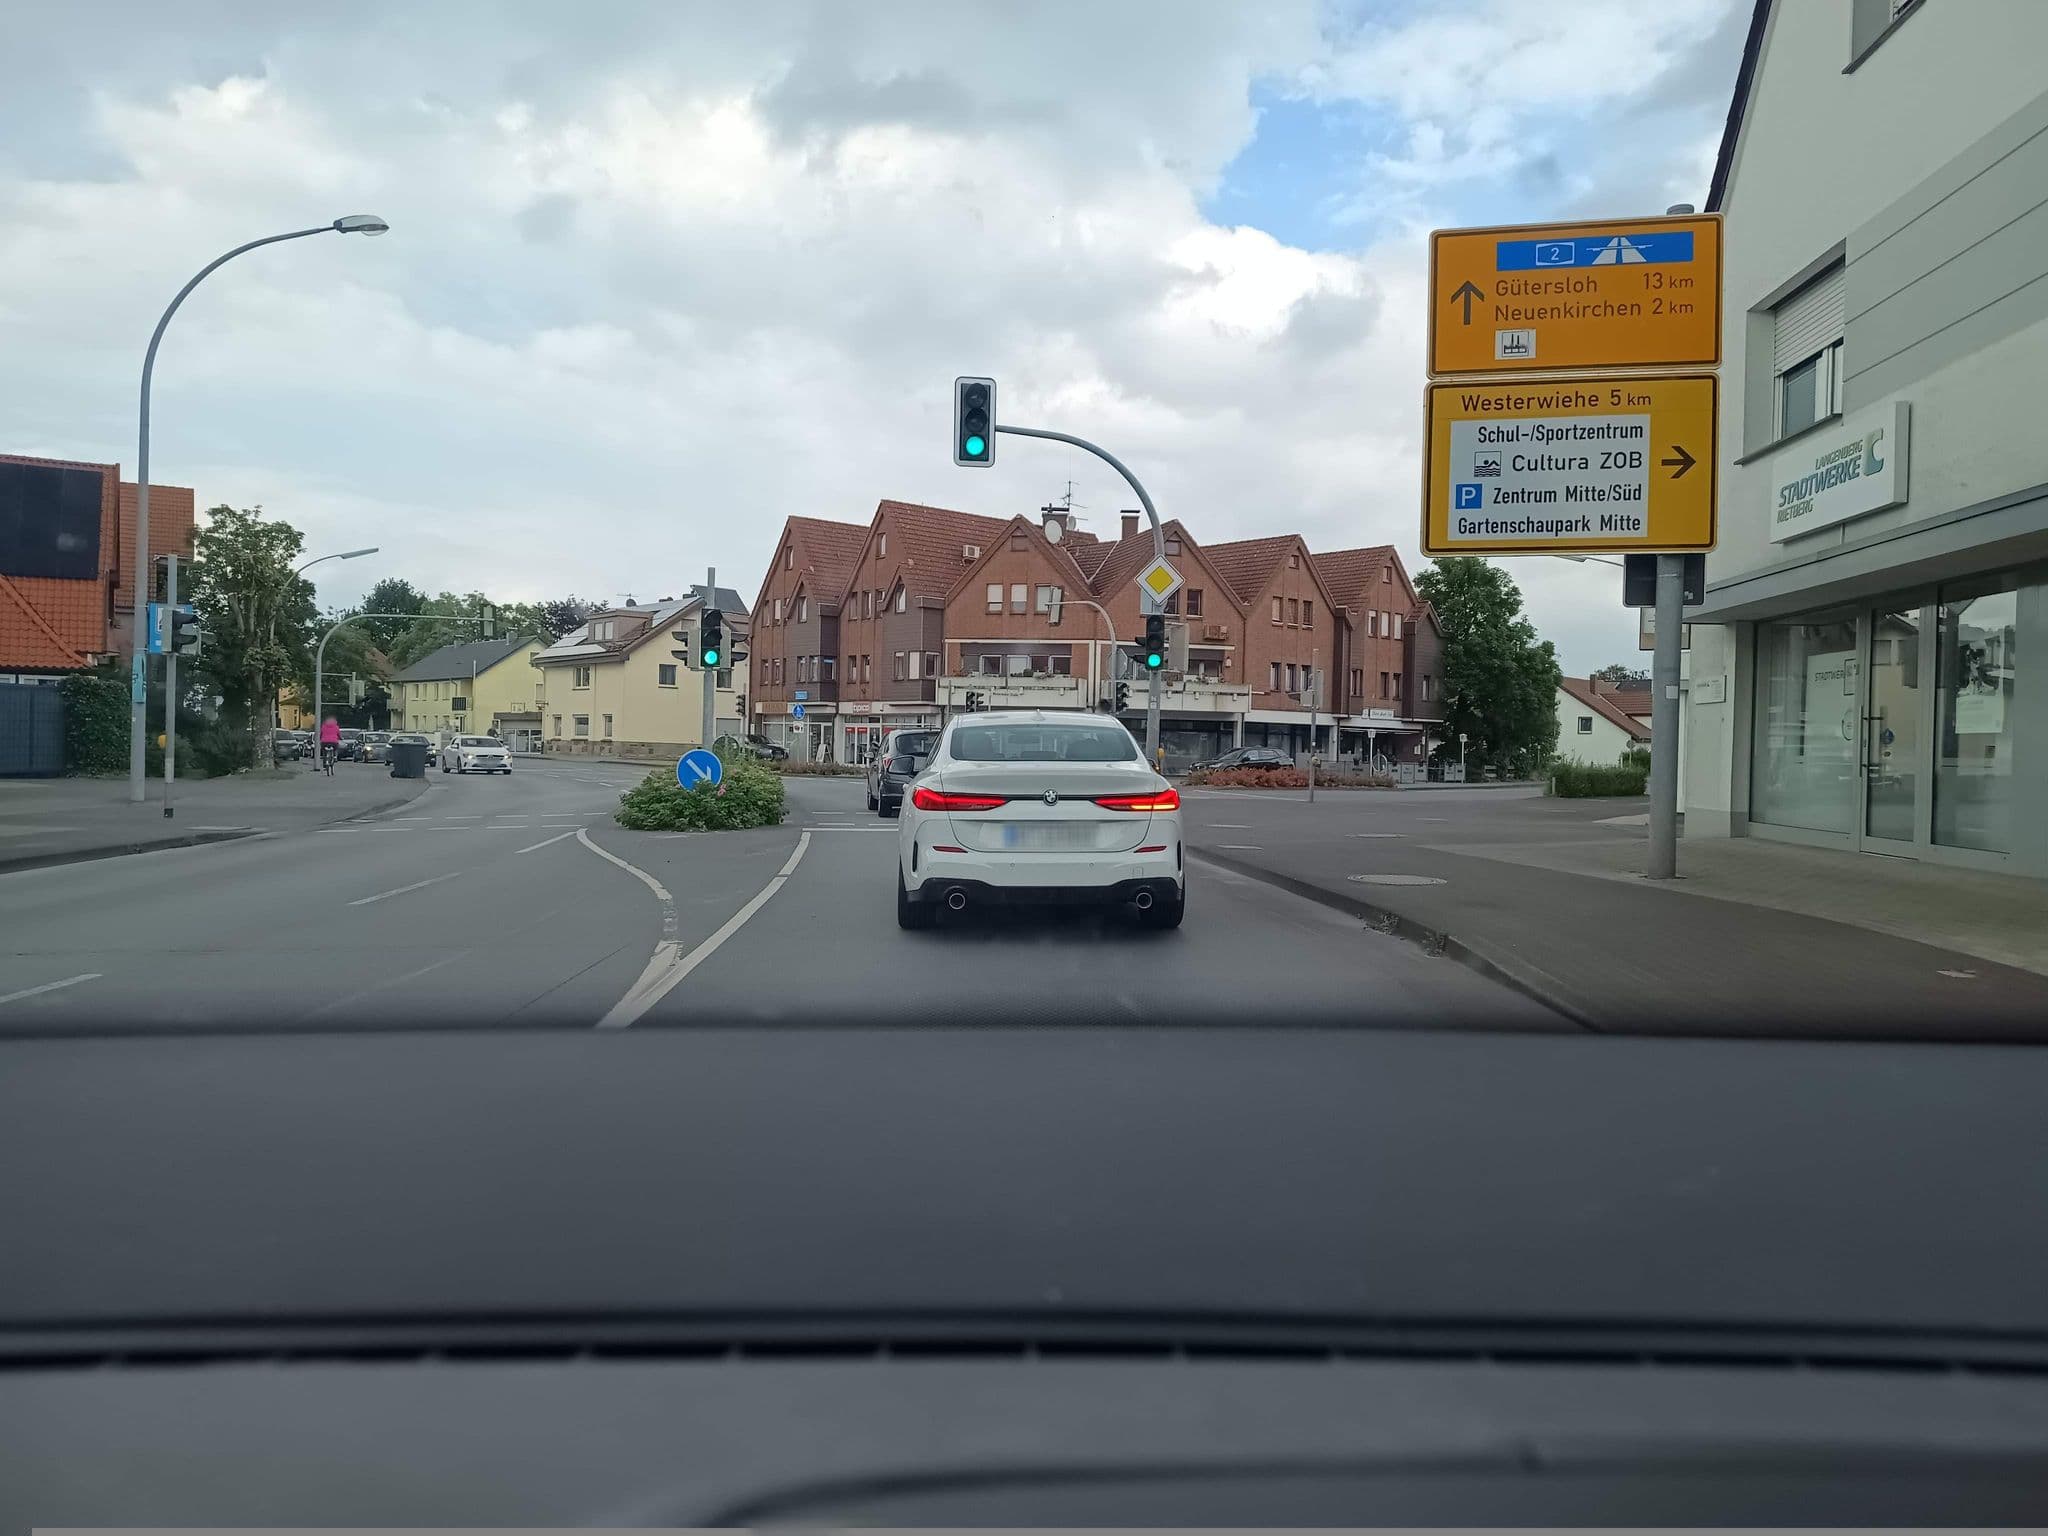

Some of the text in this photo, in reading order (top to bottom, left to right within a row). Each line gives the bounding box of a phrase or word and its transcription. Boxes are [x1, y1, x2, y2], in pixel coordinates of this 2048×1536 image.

[1551, 248, 1559, 261] 2
[1495, 272, 1694, 297] Gütersloh 13 km
[1495, 298, 1693, 321] Neuenkirchen 2 km
[1461, 390, 1651, 412] Westerwiehe 5 km
[1478, 423, 1643, 444] Schul-/Sportzentrum
[1512, 451, 1643, 472] Cultura ZOB
[1815, 439, 1863, 470] LANGENBERG
[1779, 455, 1861, 508] STADTWERKE
[1461, 487, 1476, 507] P
[1493, 484, 1642, 505] Zentrum Mitte/Süd
[1777, 498, 1813, 524] RIETBERG
[1458, 514, 1640, 537] Gartenschaupark Mitte
